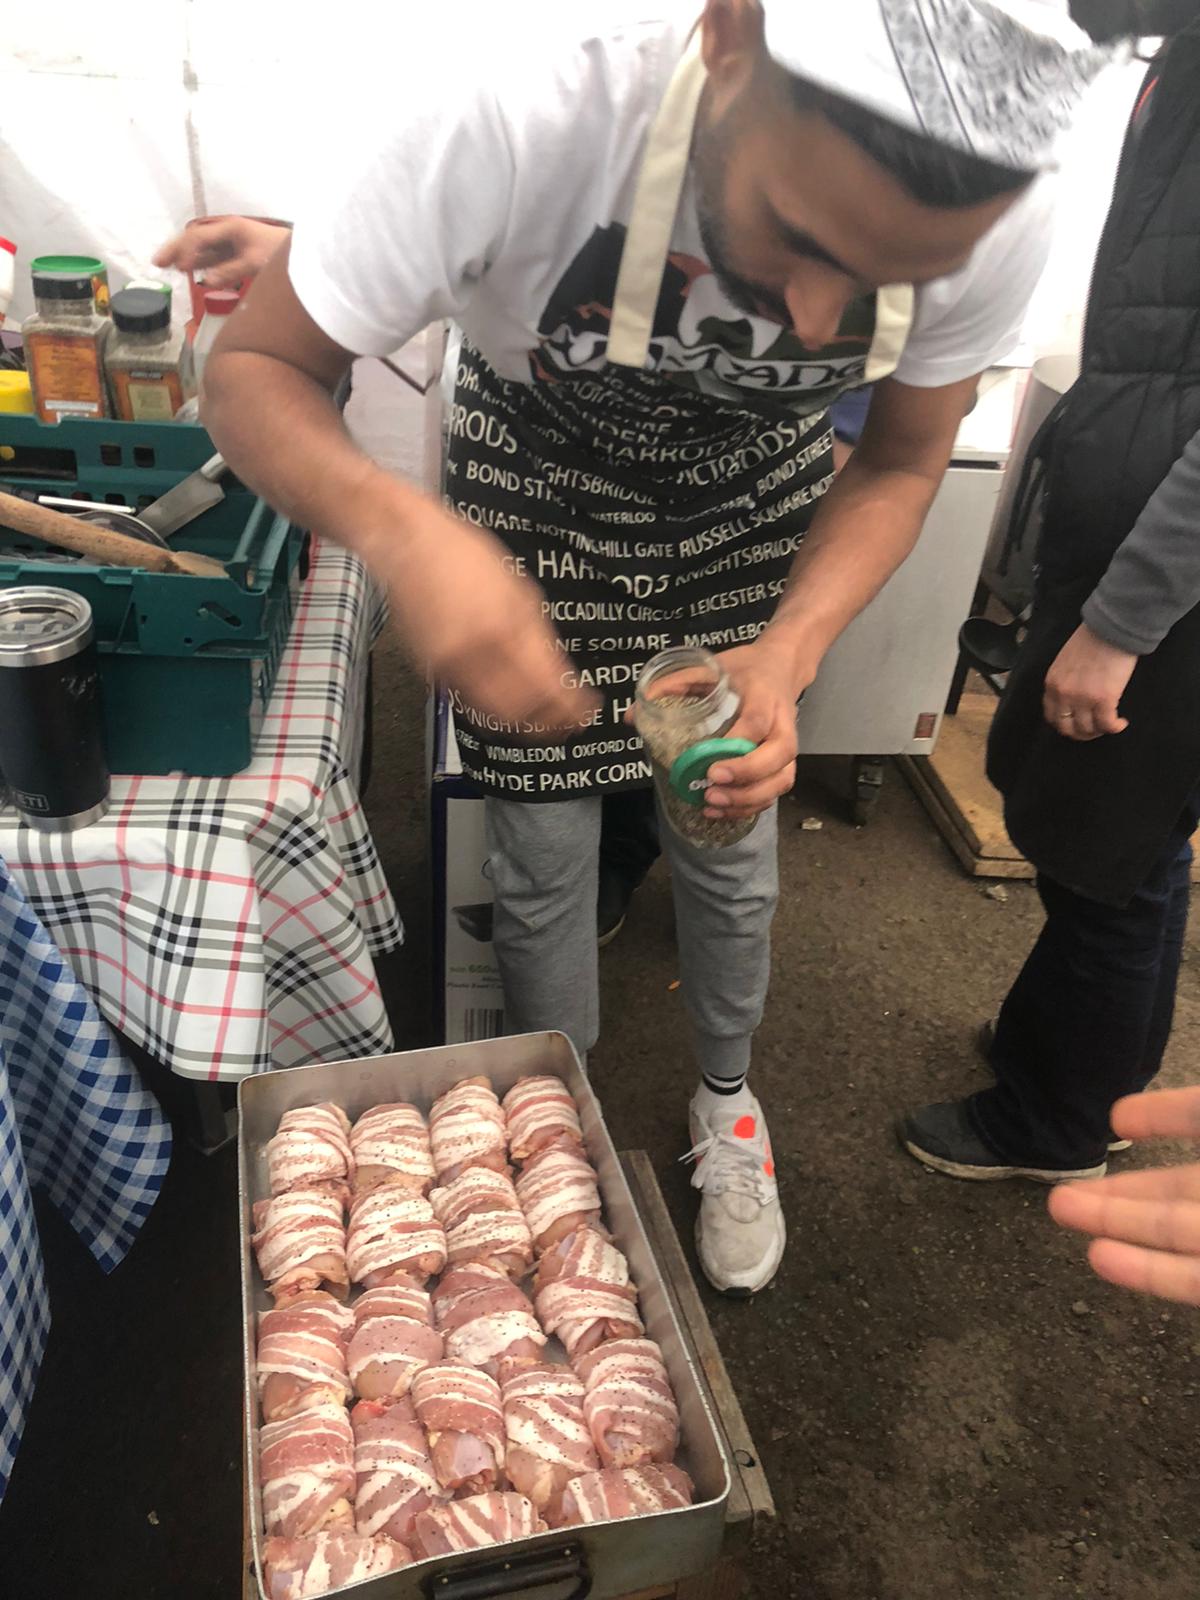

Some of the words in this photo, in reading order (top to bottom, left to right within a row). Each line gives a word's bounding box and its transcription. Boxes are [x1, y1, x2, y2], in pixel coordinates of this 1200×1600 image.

[466, 460, 521, 491] BOND
[756, 459, 797, 497] BOND
[457, 501, 533, 532] SQUARE
[600, 540, 632, 558] HILL
[634, 542, 674, 558] GATE
[679, 517, 751, 558] RUSSELL
[749, 487, 812, 528] SQUARE
[537, 549, 671, 599] HARODS
[675, 531, 808, 587] KNIGHTSBRIDG
[541, 601, 624, 621] PICCADILLY
[626, 603, 684, 622] CIRCUS
[690, 583, 767, 617] LEICESTER
[587, 633, 671, 652] SQUARE
[683, 620, 768, 648] MARYLEBO
[560, 662, 644, 690] GARDE
[484, 745, 566, 763] WIMBLEDON
[572, 738, 625, 759] OXFORD
[483, 766, 535, 792] HYDE
[540, 768, 593, 791] PARK
[595, 760, 653, 785] CORN
